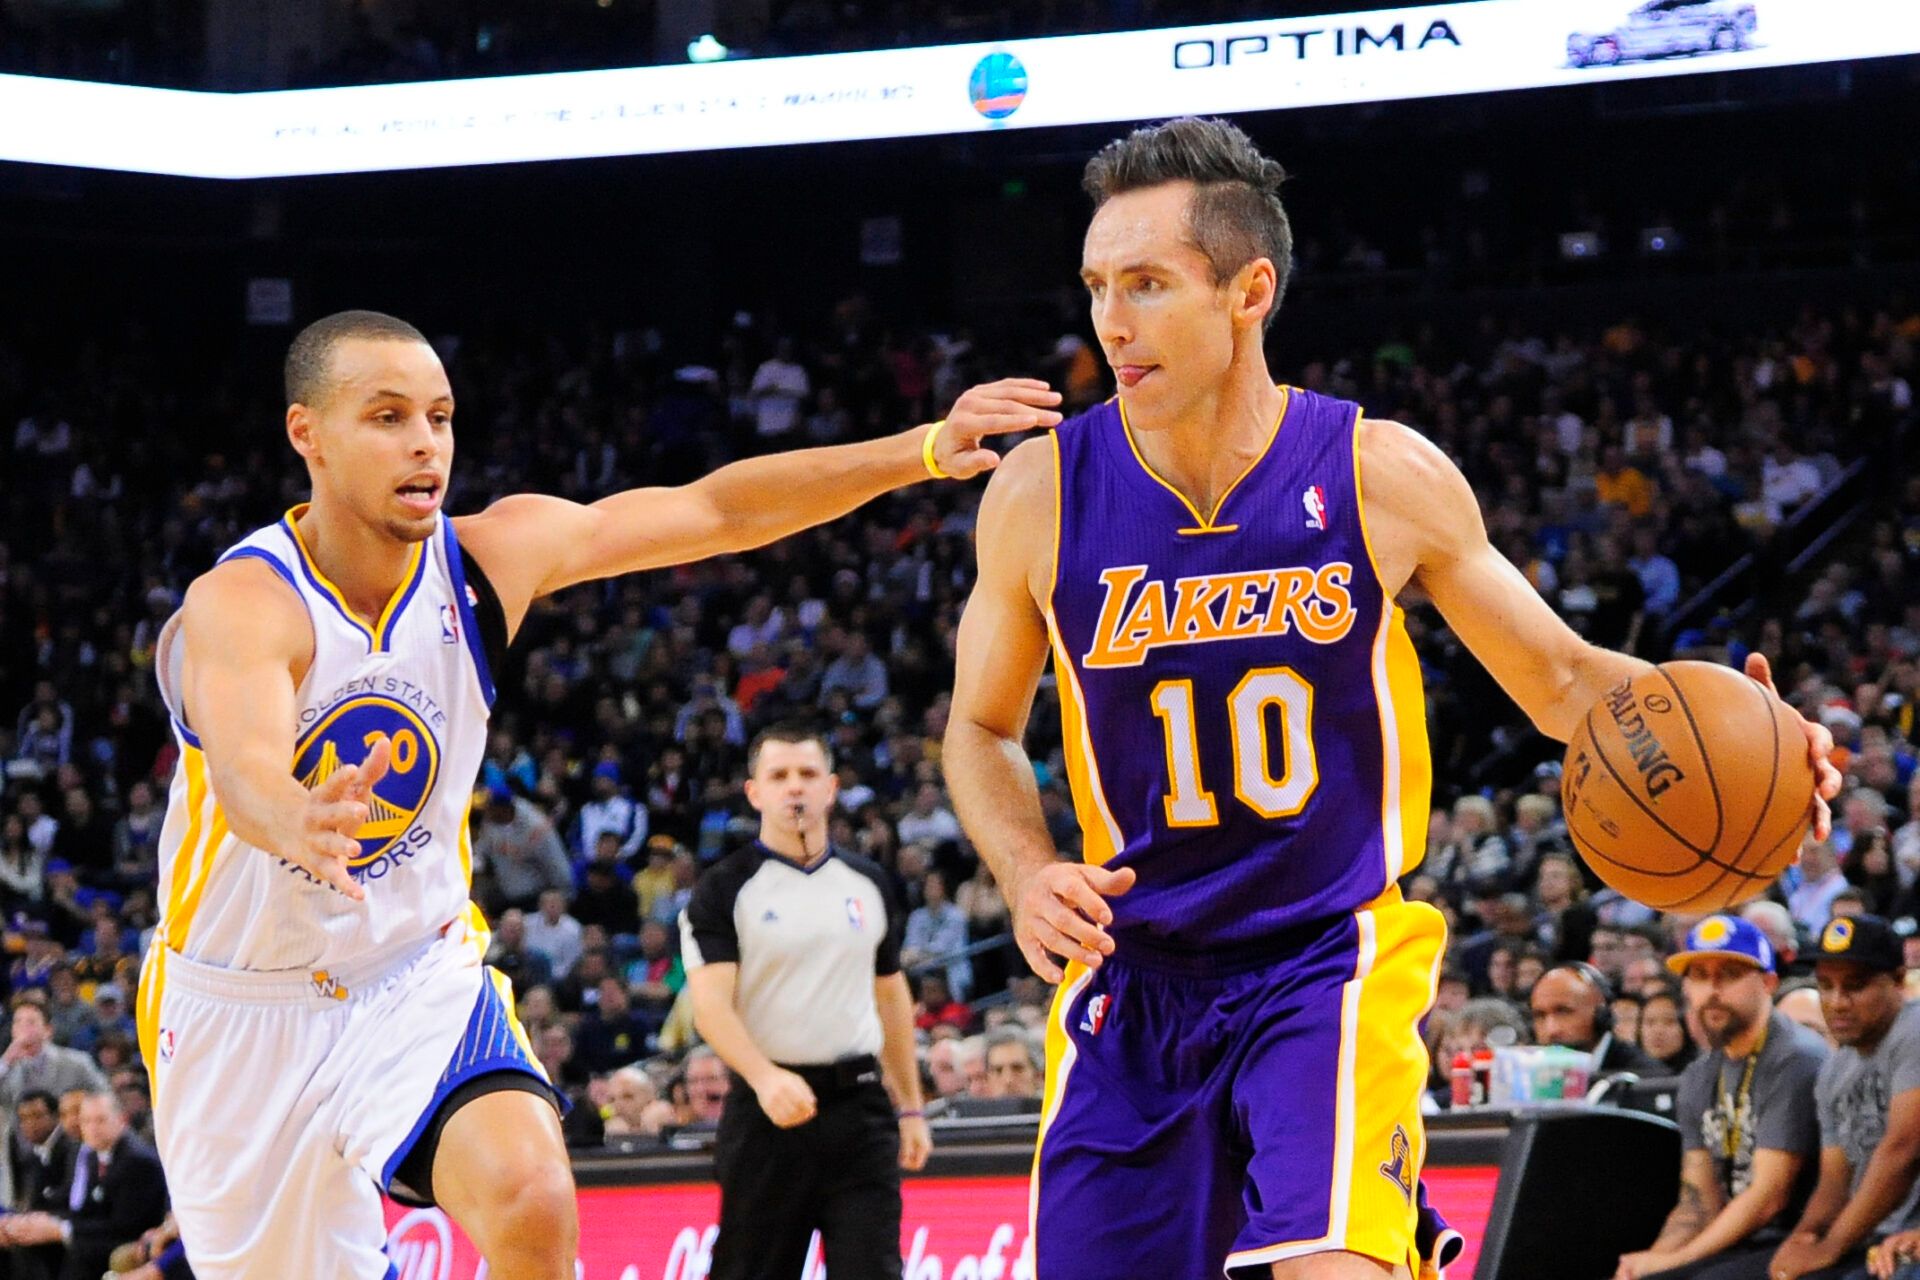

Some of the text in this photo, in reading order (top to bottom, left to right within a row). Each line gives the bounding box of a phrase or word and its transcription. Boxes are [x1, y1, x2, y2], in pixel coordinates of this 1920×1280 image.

[1174, 18, 1462, 70] OPTIMA
[1082, 561, 1358, 669] LAKERS
[295, 675, 448, 733] OLDEN STATE
[1150, 665, 1319, 828] 10
[1602, 677, 1685, 799] PALDING
